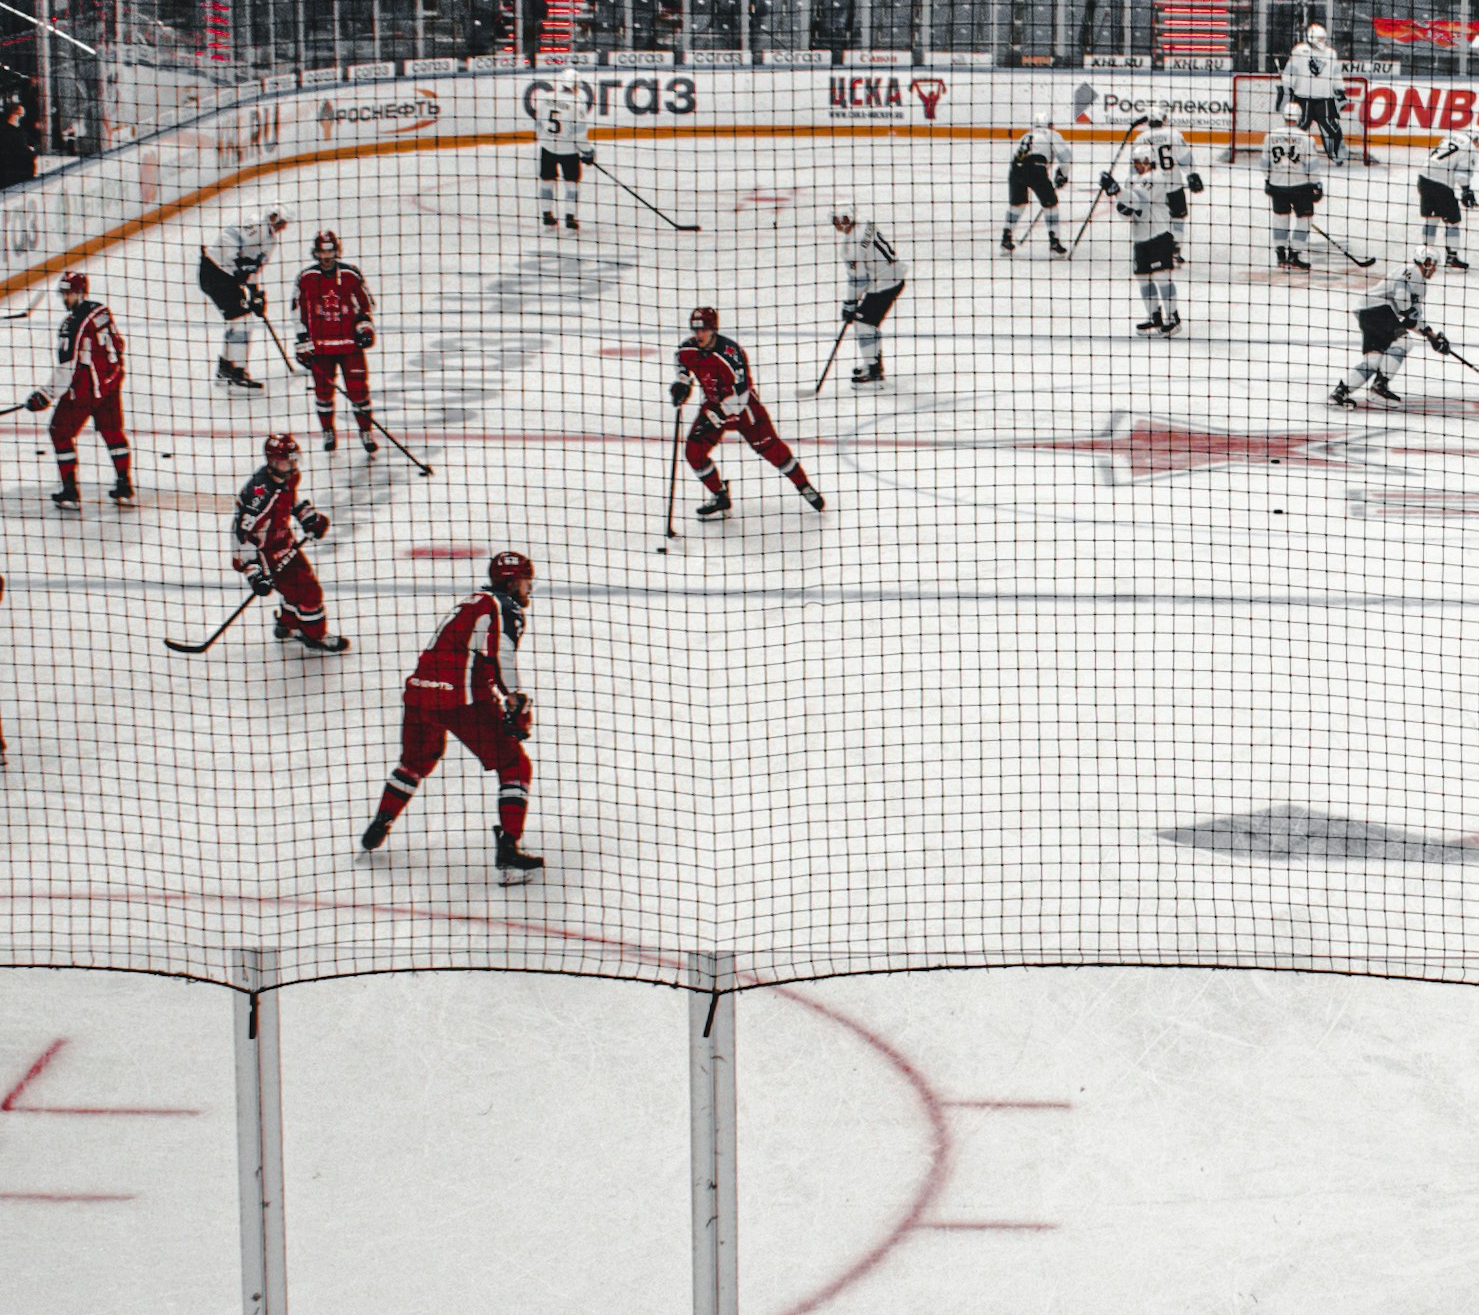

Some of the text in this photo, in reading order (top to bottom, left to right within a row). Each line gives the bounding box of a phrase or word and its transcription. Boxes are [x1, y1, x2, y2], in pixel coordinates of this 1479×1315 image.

[476, 56, 518, 70] согаз
[619, 51, 665, 65] согаз
[694, 51, 743, 64] согаз
[773, 48, 823, 64] согаз
[860, 53, 898, 64] Canon
[1092, 55, 1145, 68] KHL.RU
[412, 61, 450, 74] согаз
[1173, 57, 1225, 71] KHL.RU
[1341, 60, 1394, 74] KHL.RU
[829, 76, 904, 108] ЦСКА
[1104, 92, 1236, 115] Ростелеком
[335, 98, 441, 125] РОСНЕФТЬ
[547, 109, 562, 135] 5
[1157, 144, 1174, 171] 6
